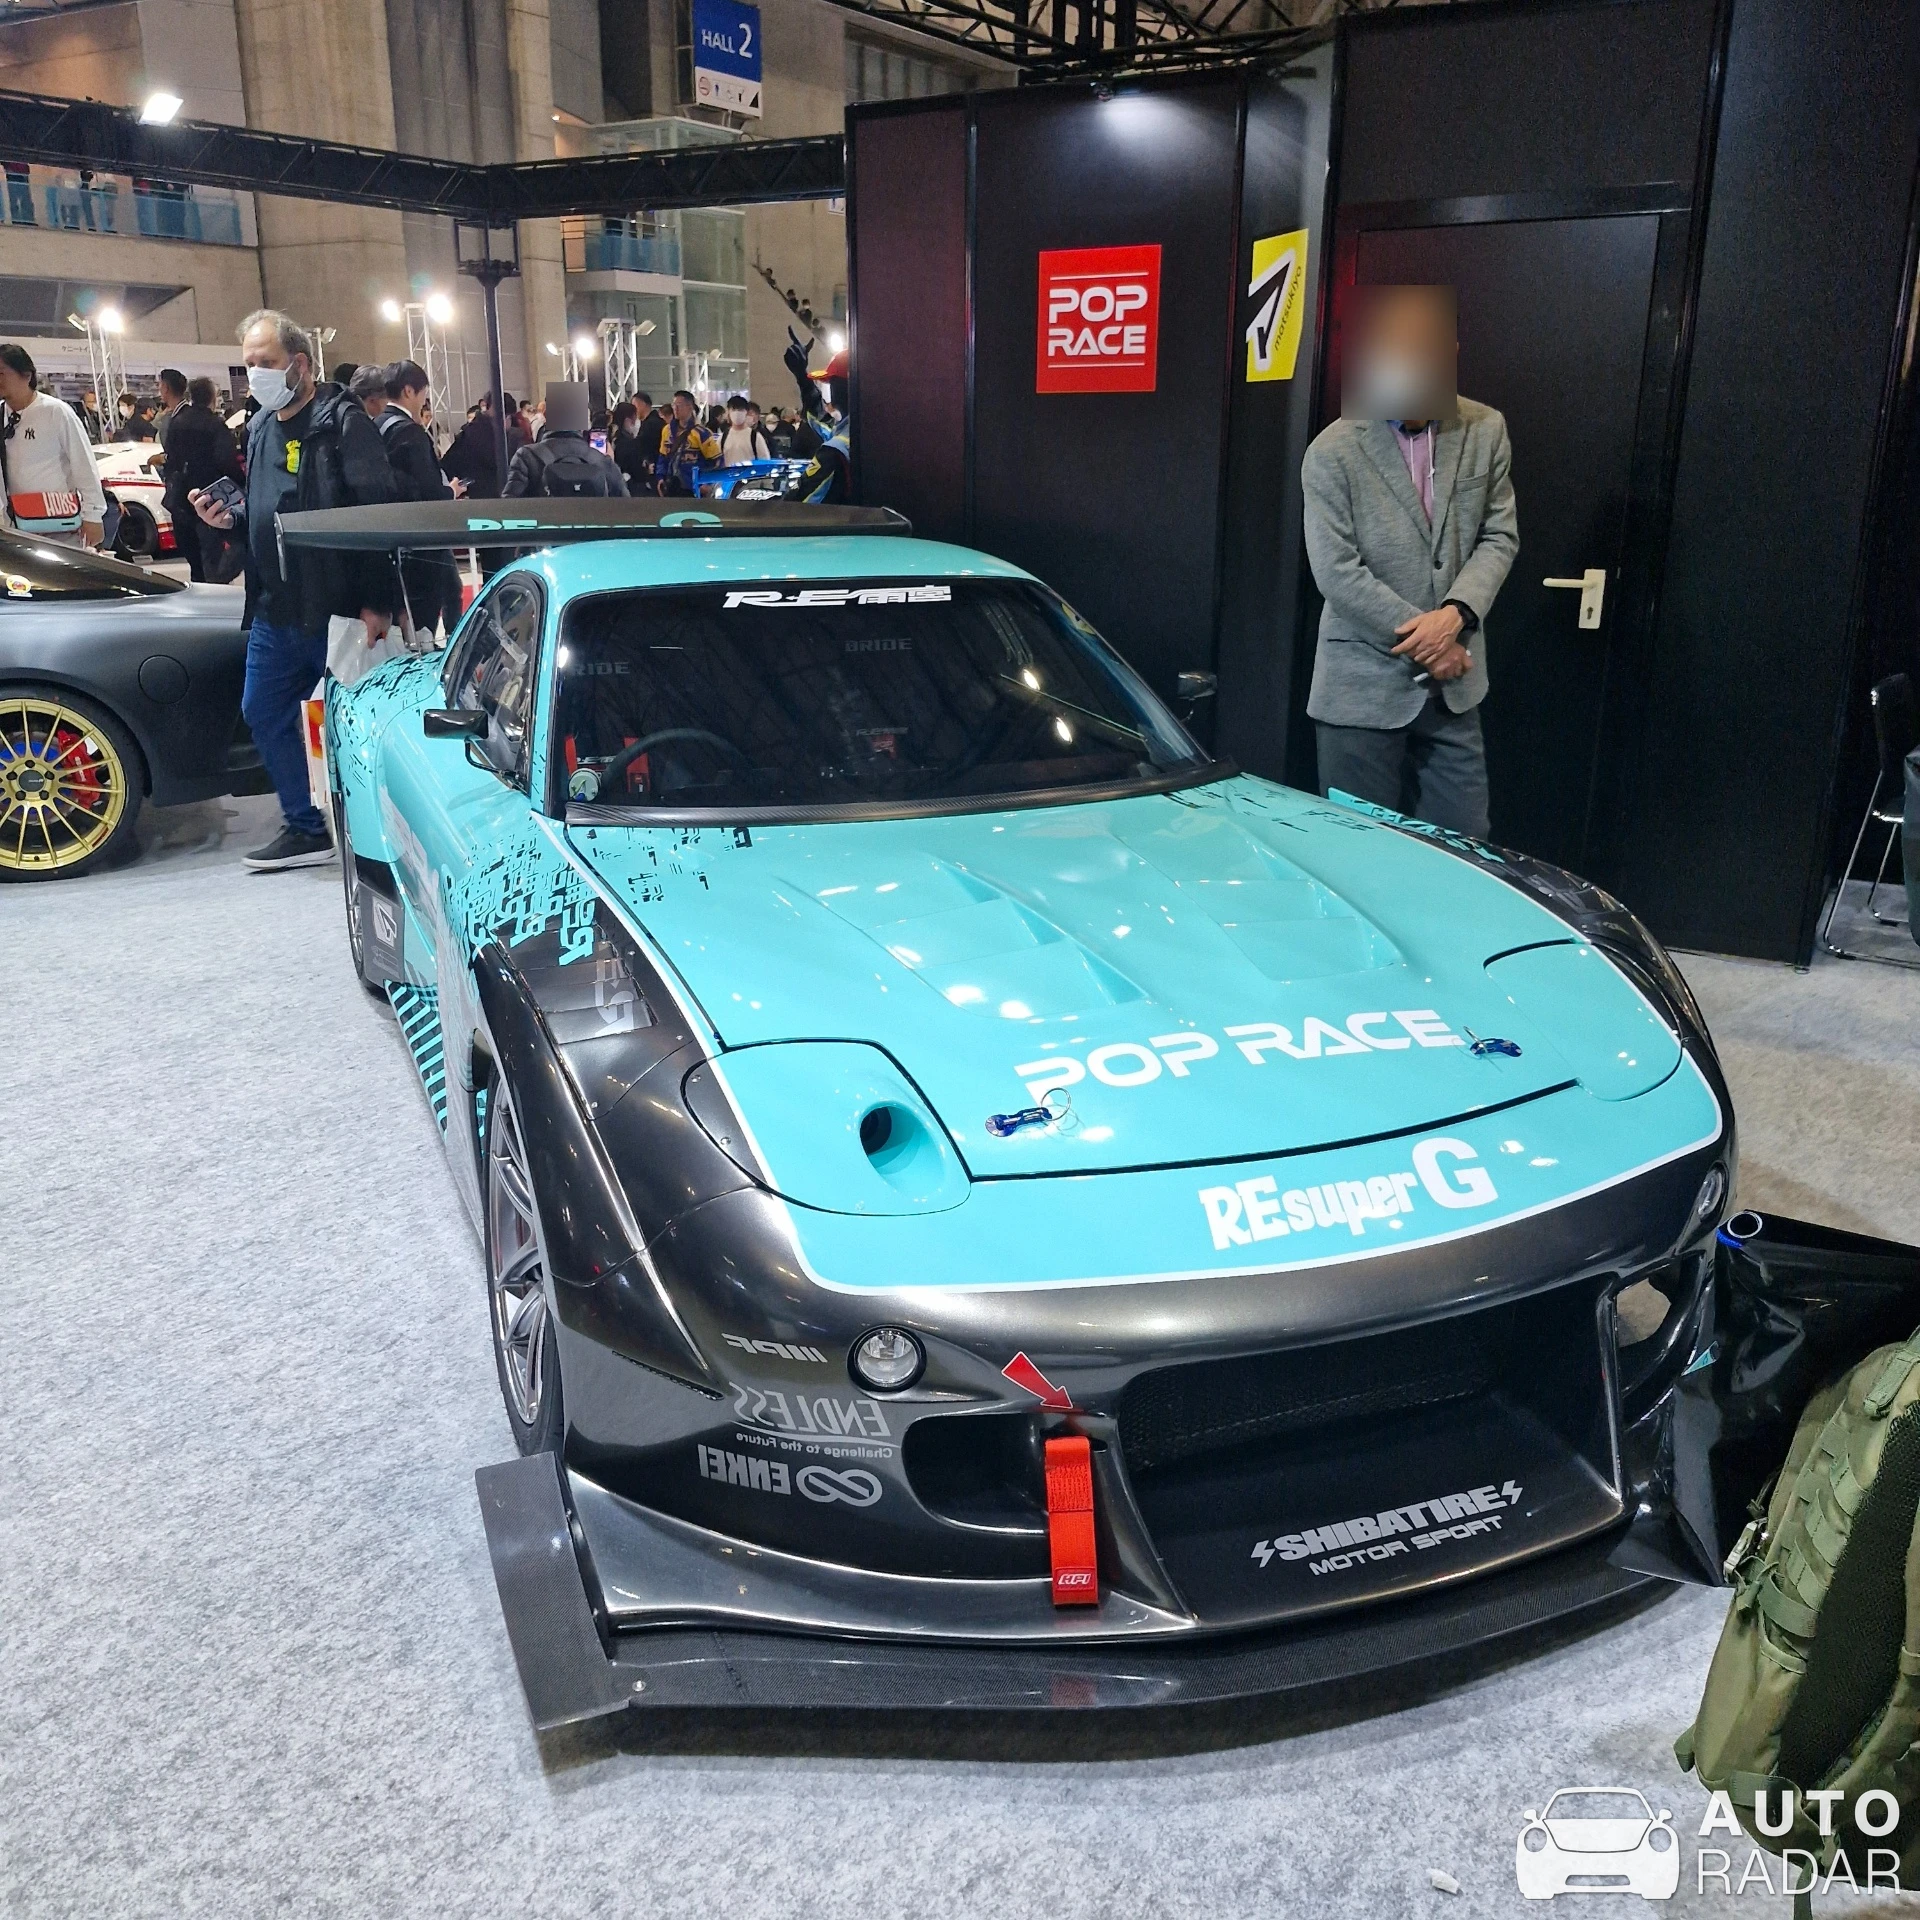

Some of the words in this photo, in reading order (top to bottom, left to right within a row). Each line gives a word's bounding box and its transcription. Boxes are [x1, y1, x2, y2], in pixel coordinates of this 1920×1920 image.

[702, 29, 736, 54] HALL
[739, 22, 753, 59] 2
[1048, 284, 1149, 324] POP
[1274, 265, 1302, 352] matsukiyo
[1047, 325, 1147, 357] RACE
[845, 638, 913, 652] BRIDE
[1014, 1031, 1219, 1108] POP
[1224, 1009, 1466, 1066] RACE
[1273, 1484, 1508, 1562] SHIBATIRE
[1308, 1540, 1411, 1577] MOTOR
[1410, 1514, 1503, 1551] SPORT
